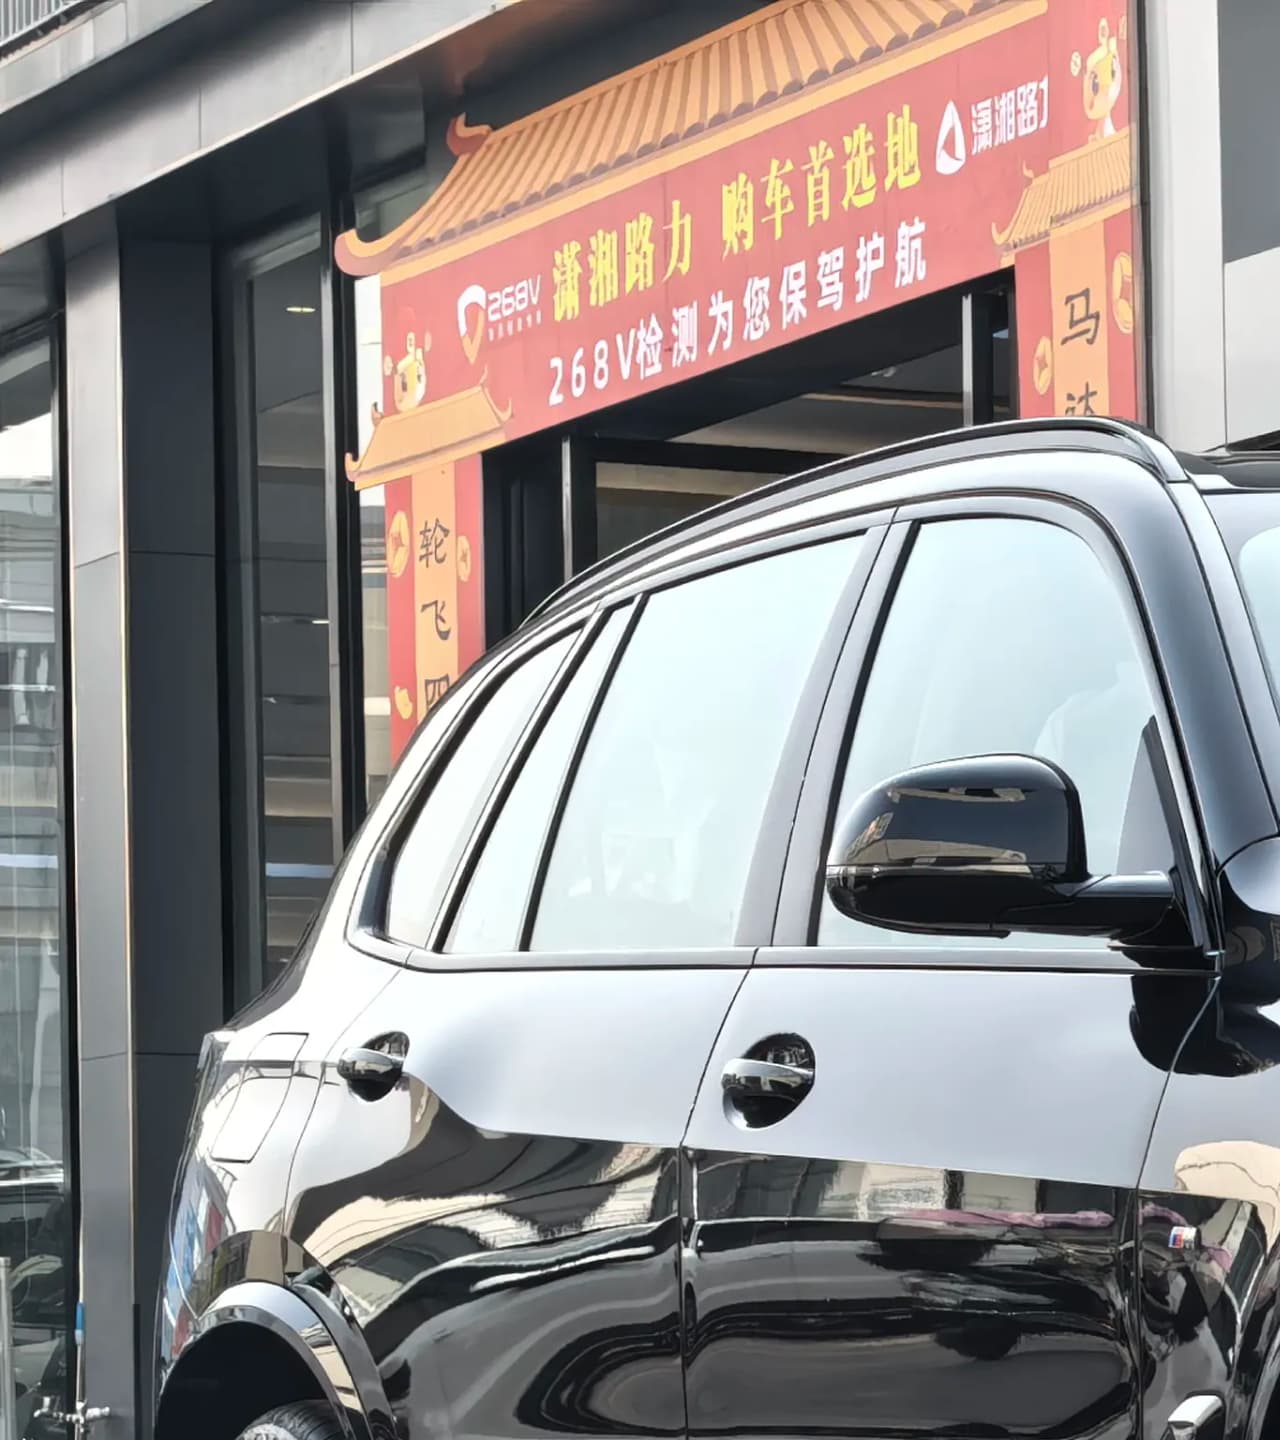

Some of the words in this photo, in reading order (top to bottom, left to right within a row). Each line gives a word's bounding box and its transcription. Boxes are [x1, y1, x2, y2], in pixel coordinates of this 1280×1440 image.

[552, 199, 693, 322] 潇湘路力
[720, 103, 922, 260] 购车首选地
[487, 274, 542, 322] 268V
